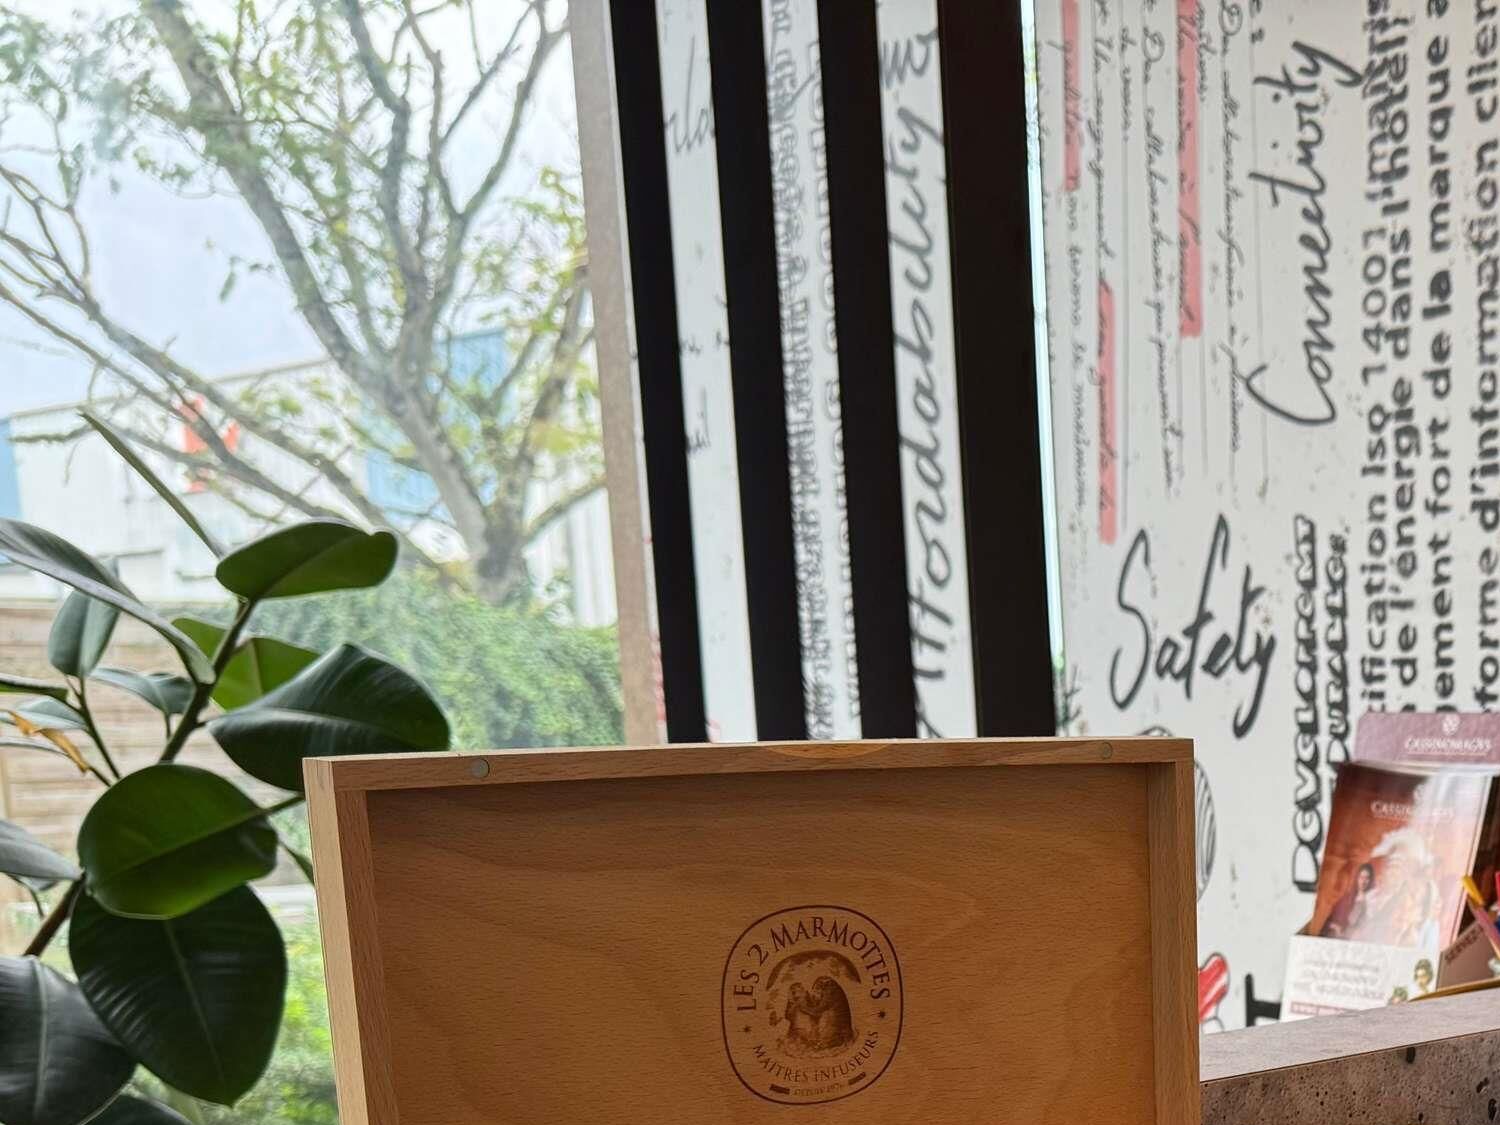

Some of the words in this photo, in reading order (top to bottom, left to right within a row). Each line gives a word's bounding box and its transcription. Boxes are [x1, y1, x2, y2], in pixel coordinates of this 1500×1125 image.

[1424, 34, 1454, 253] marque
[1244, 40, 1364, 428] Connectivity
[1361, 228, 1388, 386] 14001
[1384, 228, 1412, 360] dans
[1421, 269, 1452, 320] la
[1422, 331, 1452, 400] de
[1423, 416, 1452, 518] fort
[1109, 513, 1277, 739] Safety
[1390, 622, 1418, 687] de
[733, 968, 761, 1012] LES
[747, 943, 769, 967] 2
[769, 916, 892, 1001] MARMOTTES
